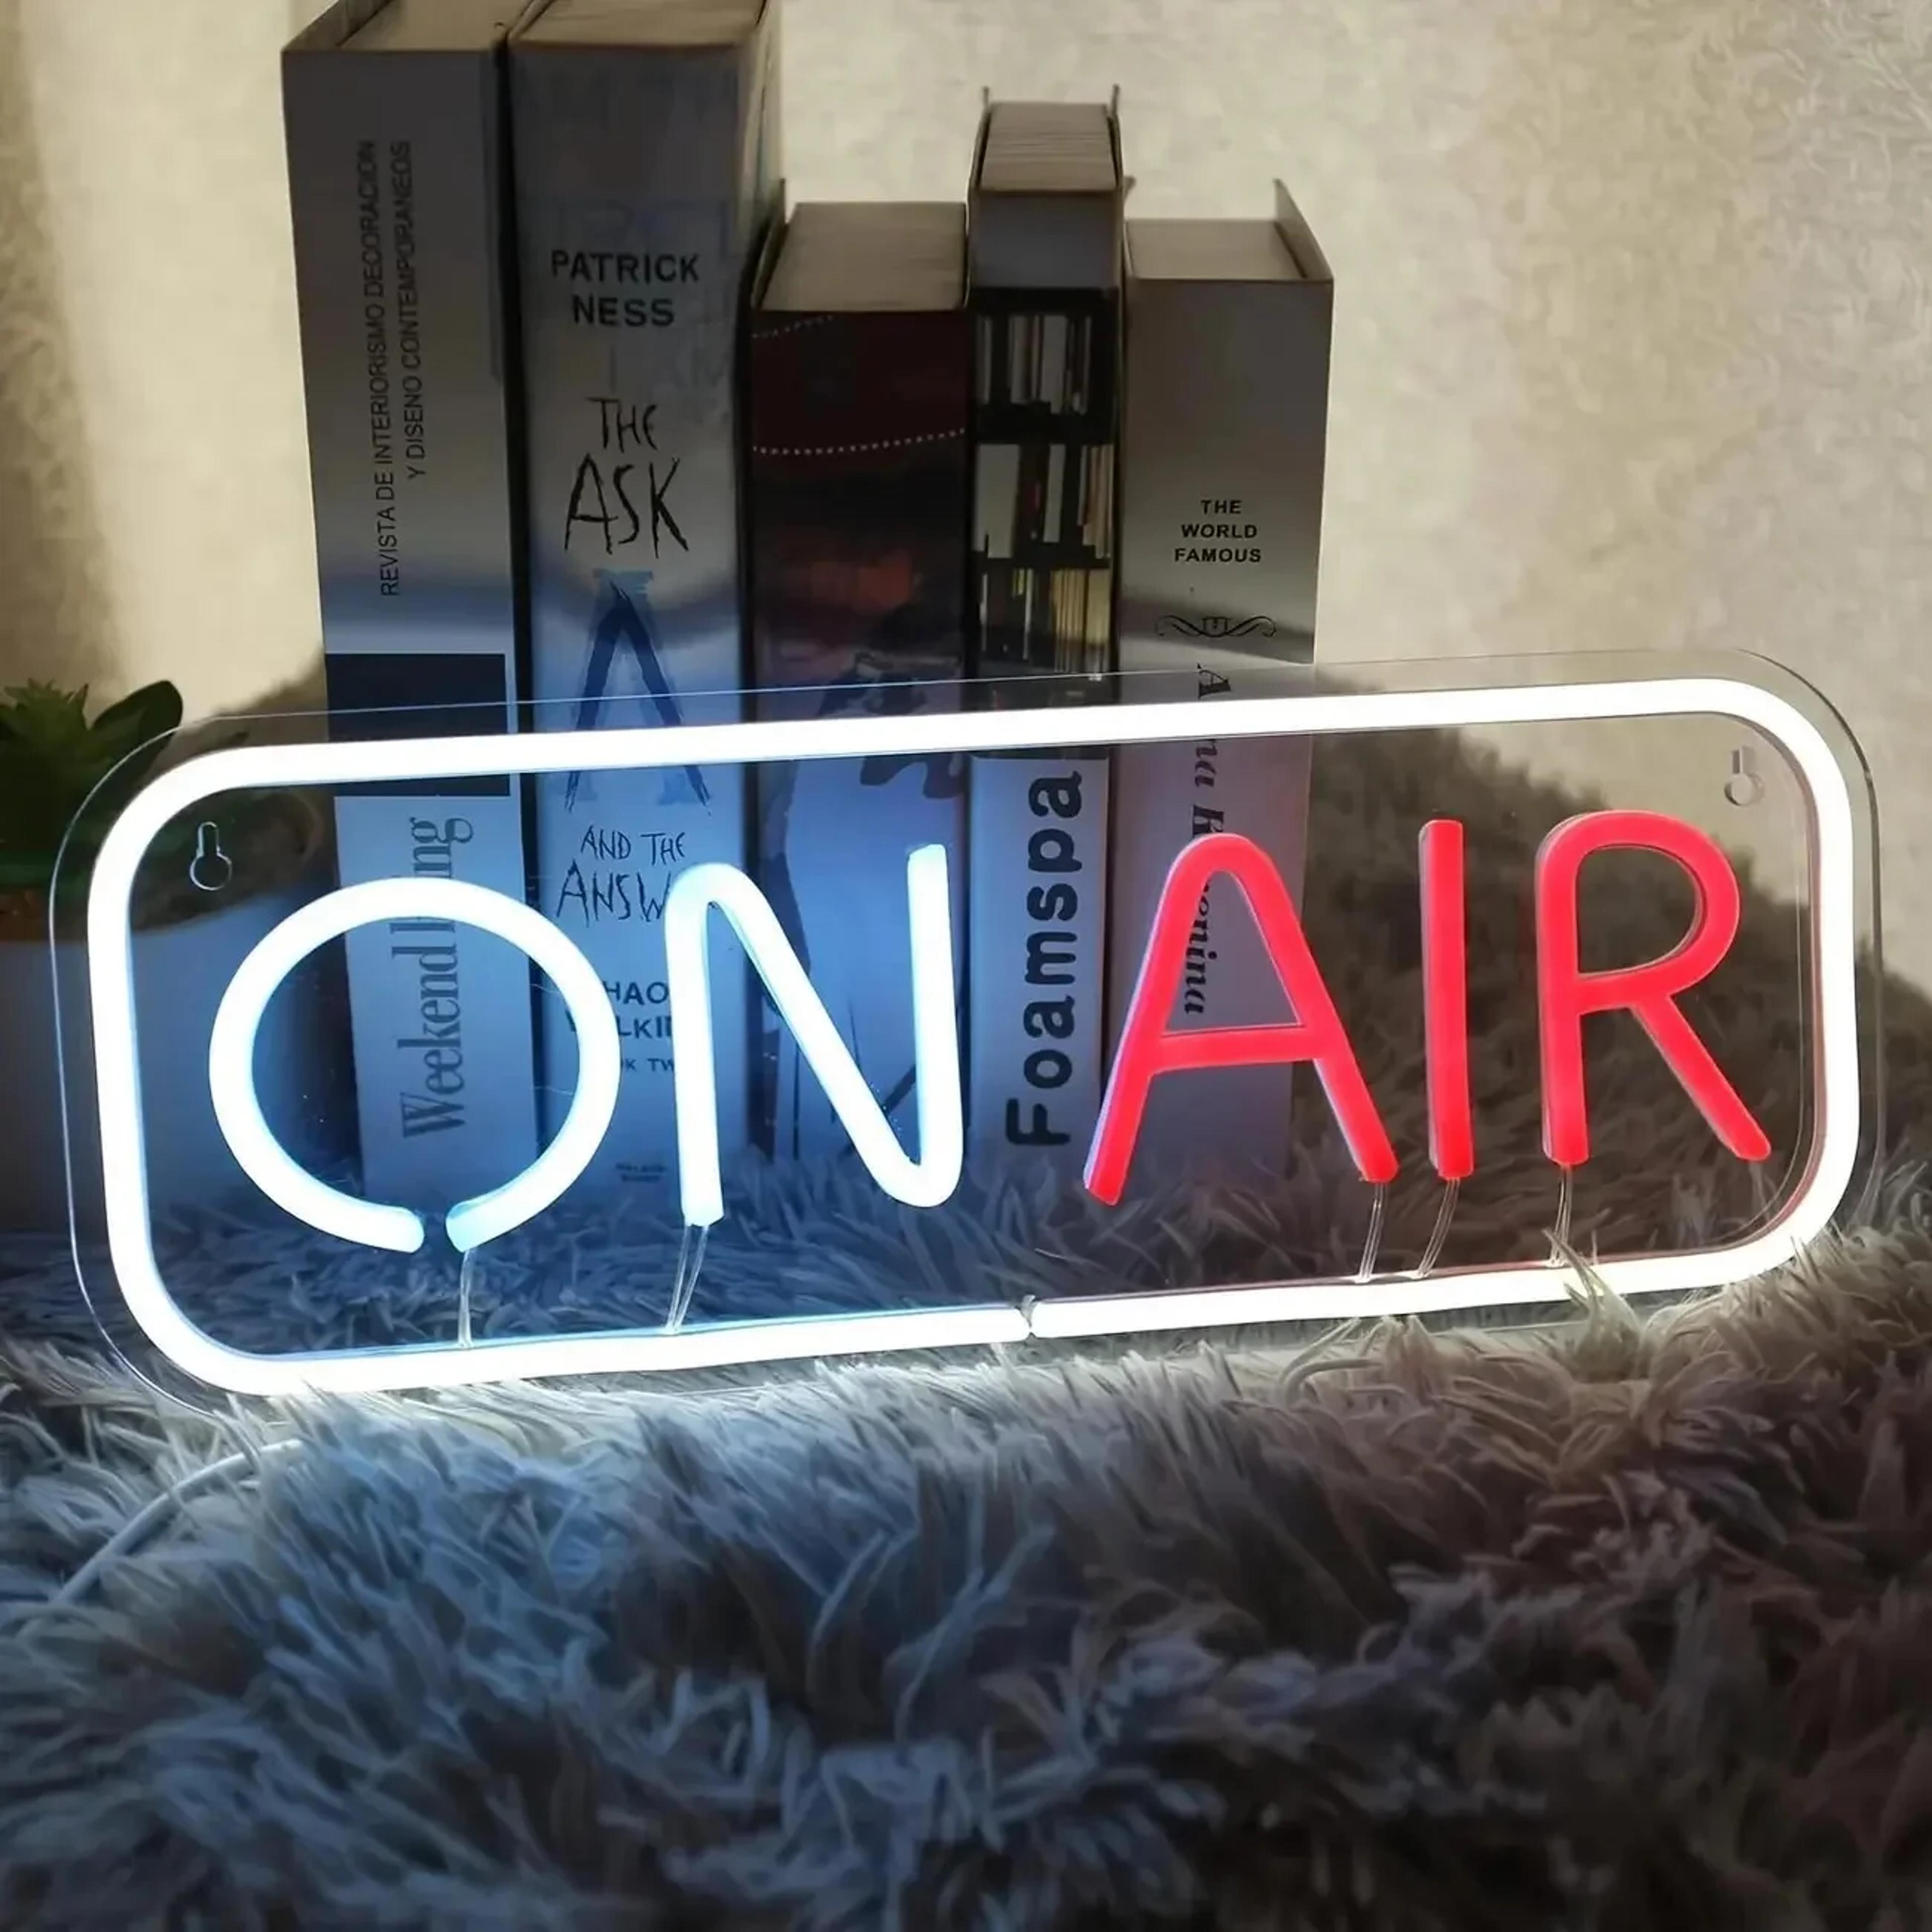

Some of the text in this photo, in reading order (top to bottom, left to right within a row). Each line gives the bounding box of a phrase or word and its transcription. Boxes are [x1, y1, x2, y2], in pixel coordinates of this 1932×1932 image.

[389, 140, 421, 370] CONTEMPORANEOS
[551, 250, 700, 284] PATRICK
[572, 293, 675, 327] NESS
[355, 140, 399, 597] REVISTA DE INTERIORISMO DECORACION
[585, 396, 659, 453] THE
[406, 465, 426, 480] Y
[564, 453, 690, 559] ASK
[1200, 499, 1242, 515] THE
[1174, 547, 1261, 562] FAMOUS
[1181, 524, 1258, 539] WORLD
[1193, 663, 1231, 788] Ana
[580, 824, 686, 866] AND THE
[556, 857, 671, 928] ANSW
[1006, 770, 1083, 1147] Foamspa
[602, 980, 670, 1006] HAO
[208, 809, 1772, 1254] ON AIR
[390, 943, 466, 1139] Weekend
[647, 1058, 675, 1072] TW
